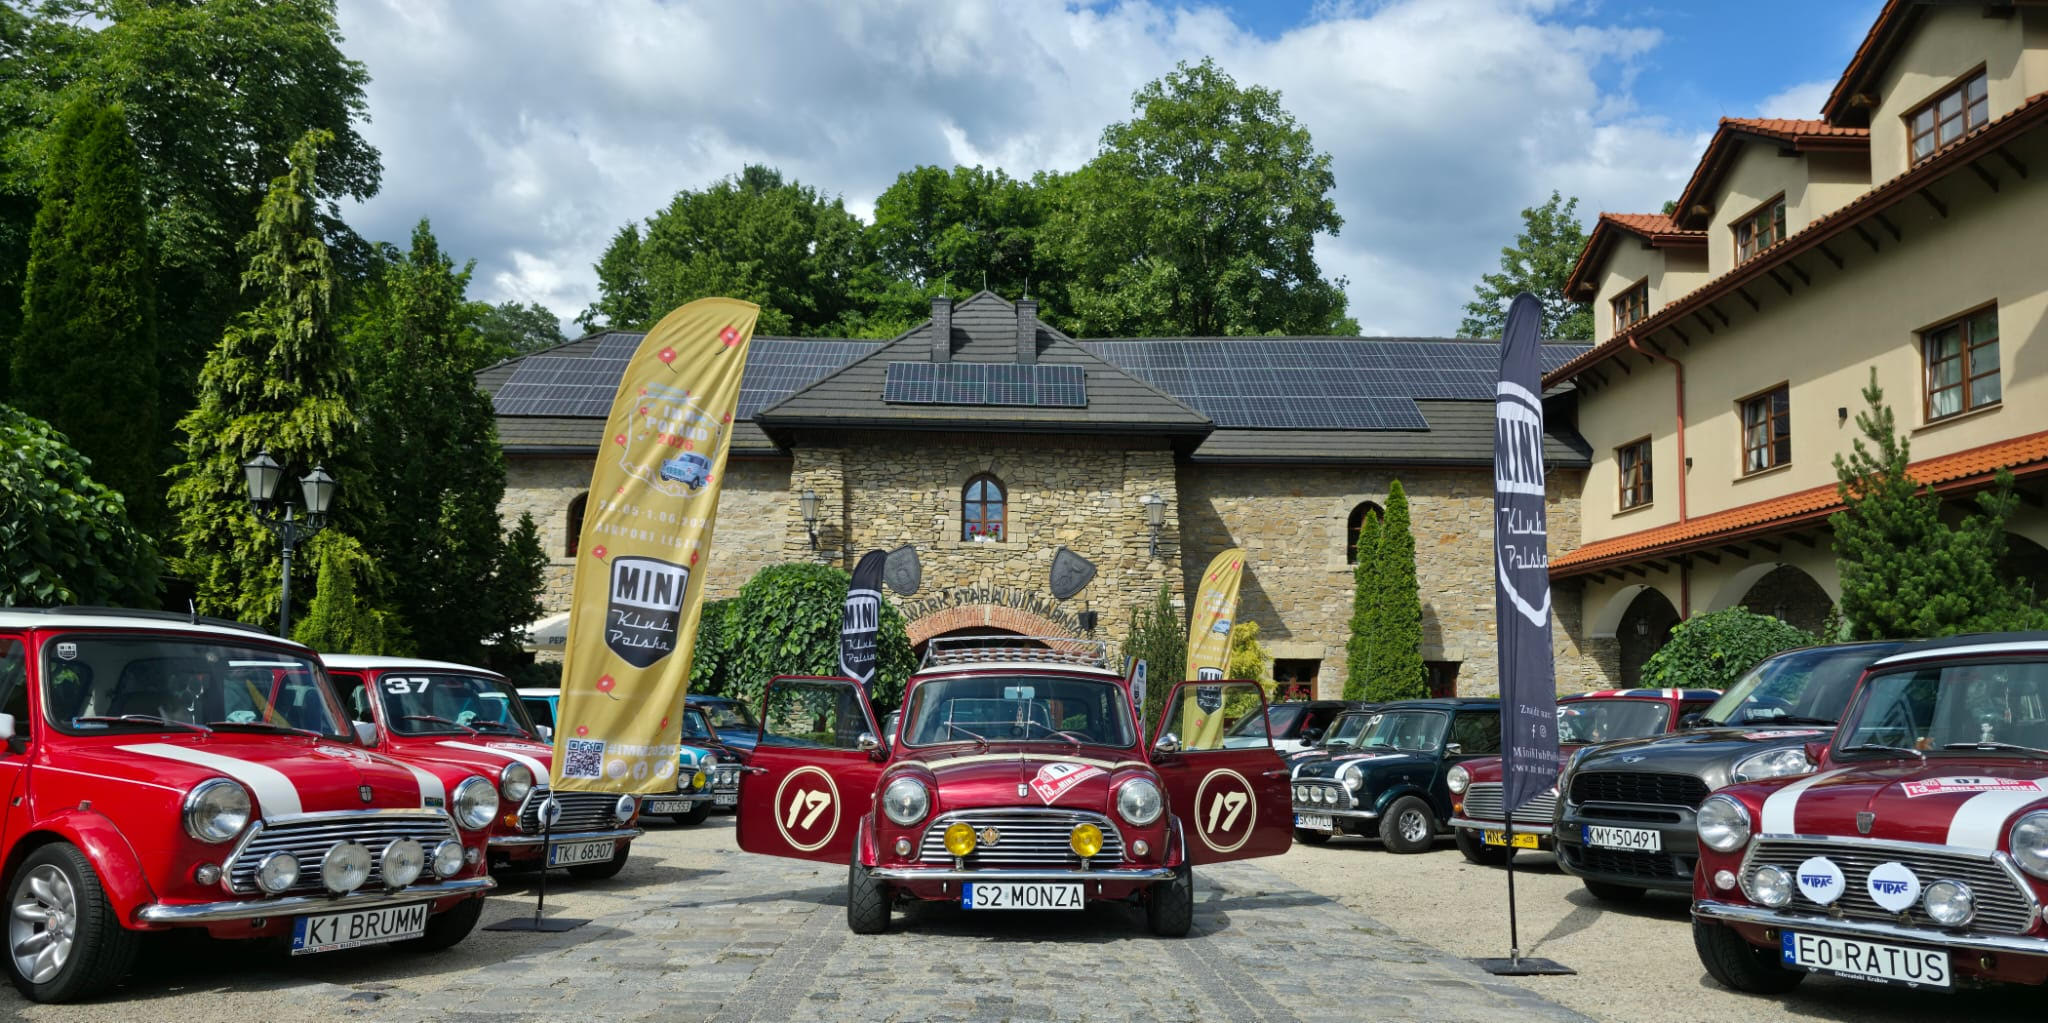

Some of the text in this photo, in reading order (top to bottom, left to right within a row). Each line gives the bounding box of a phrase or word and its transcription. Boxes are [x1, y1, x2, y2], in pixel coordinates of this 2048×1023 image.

[657, 432, 694, 451] 2026
[1497, 418, 1543, 486] MINI
[1501, 508, 1546, 534] Klub
[1505, 545, 1549, 570] Polska
[617, 565, 686, 606] MINI
[612, 609, 674, 632] Klub
[844, 603, 876, 629] MINI
[609, 629, 671, 650] Polska
[385, 677, 430, 694] 37
[787, 789, 831, 830] 17
[1207, 791, 1248, 833] 17
[1590, 827, 1657, 849] KMY 50491
[581, 843, 613, 860] 68307
[1801, 875, 1832, 888] WIPAC
[1872, 879, 1908, 894] WIPAC
[976, 886, 1002, 906] S2
[1011, 886, 1082, 907] MONZA
[309, 916, 339, 945] K1
[349, 906, 424, 940] BRUMM
[1785, 950, 1795, 959] PL
[1844, 942, 1944, 982] RATUS
